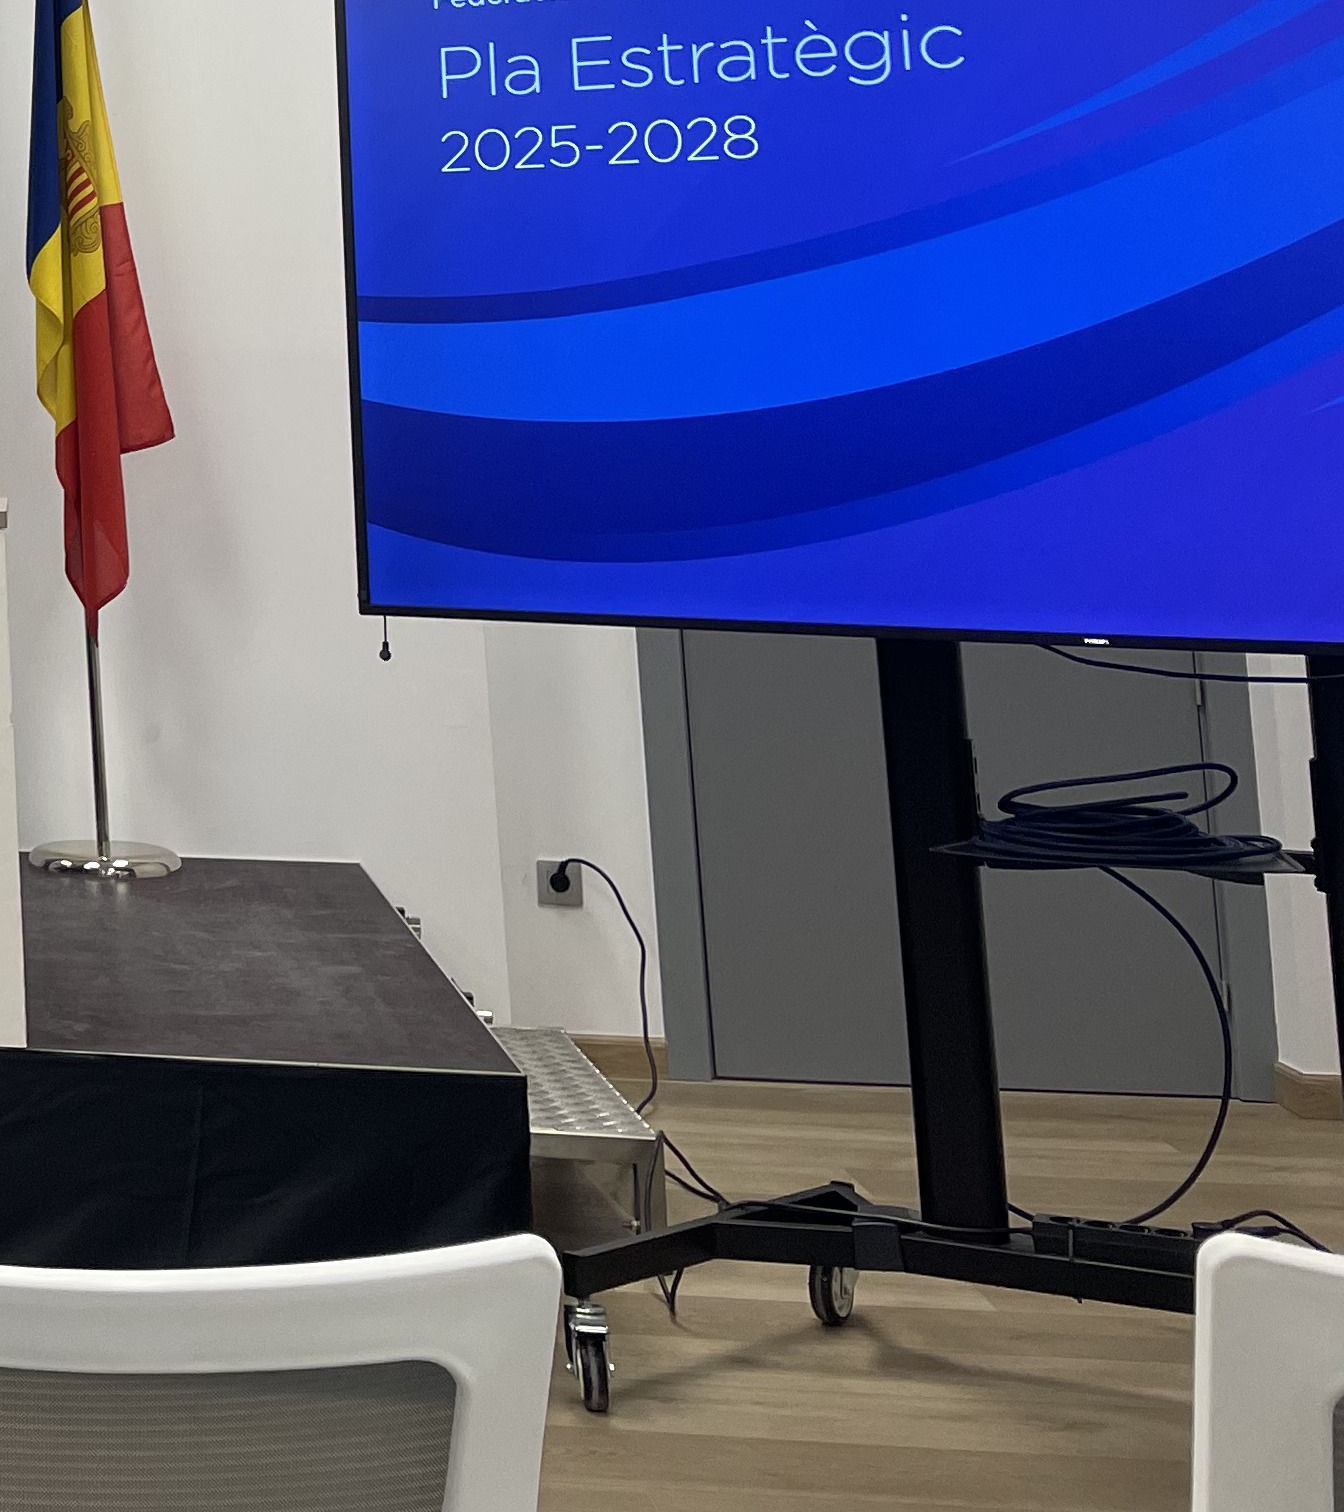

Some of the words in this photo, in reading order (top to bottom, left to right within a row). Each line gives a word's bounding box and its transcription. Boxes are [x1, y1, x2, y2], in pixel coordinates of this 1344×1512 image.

[440, 41, 541, 99] Pla
[571, 13, 965, 91] Estratègic
[440, 114, 759, 173] 2025-2028
